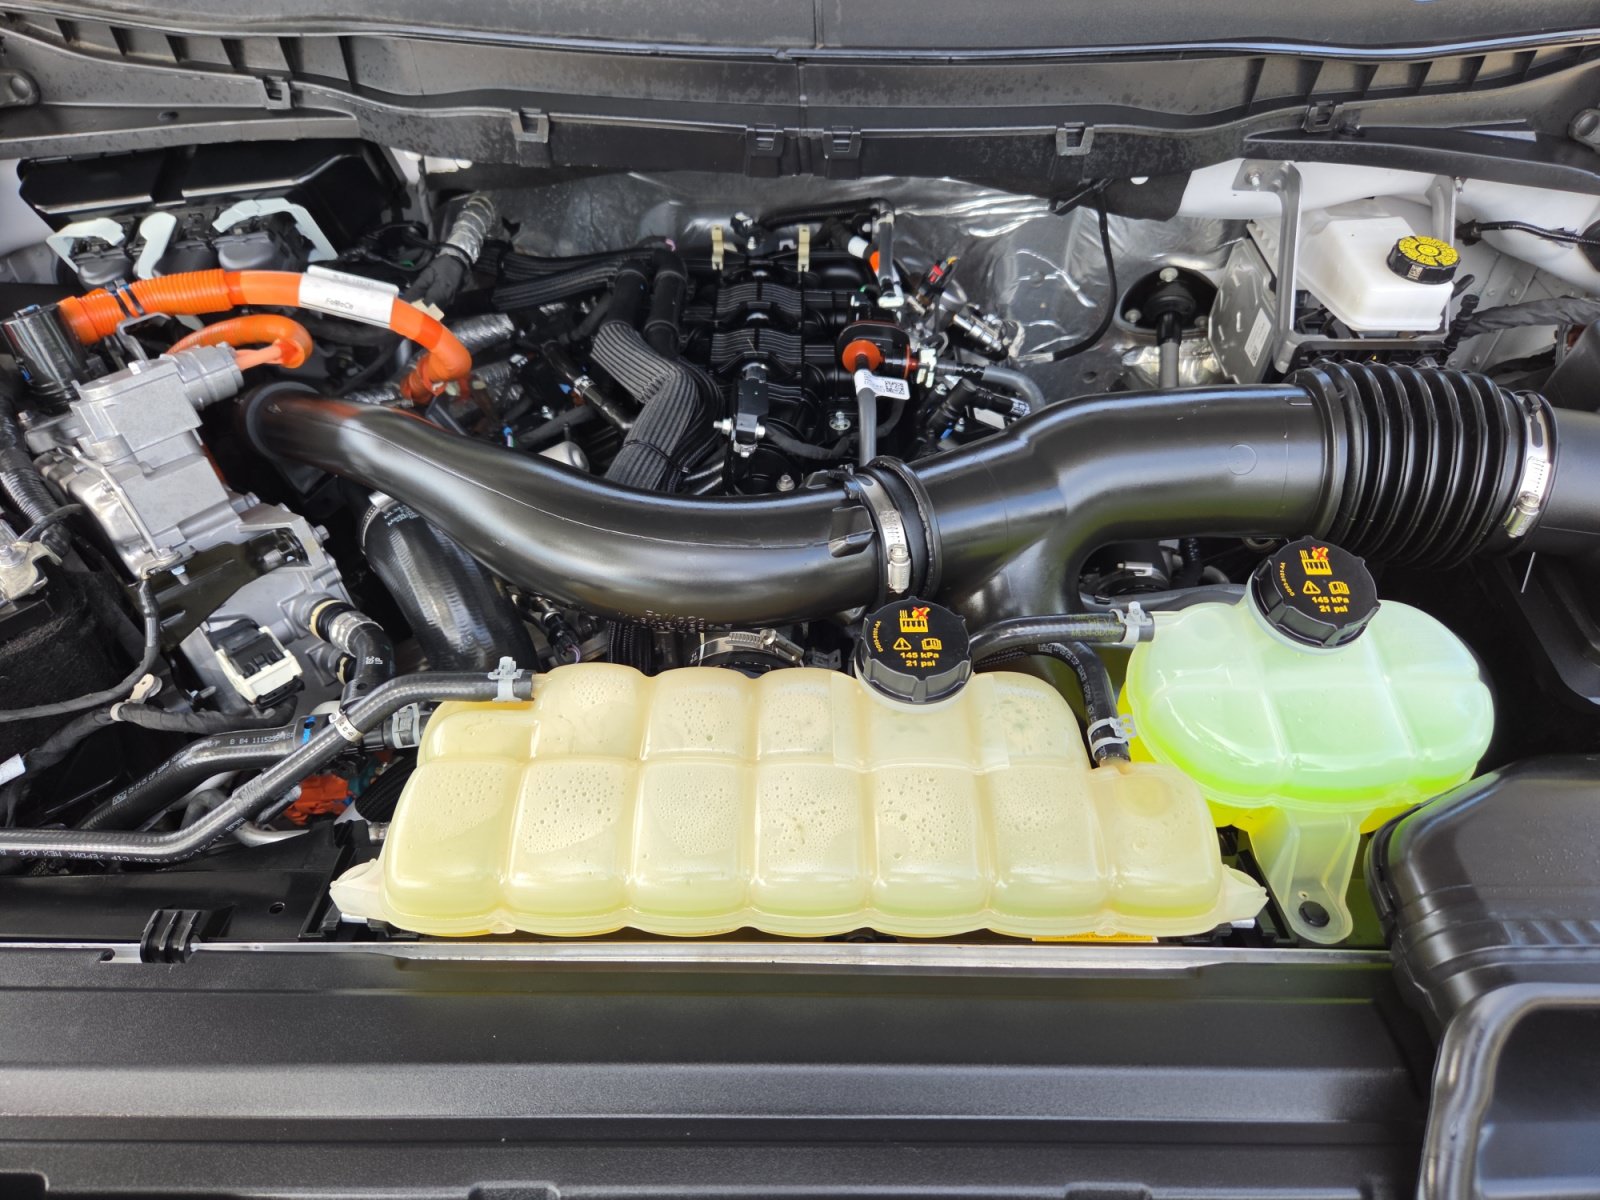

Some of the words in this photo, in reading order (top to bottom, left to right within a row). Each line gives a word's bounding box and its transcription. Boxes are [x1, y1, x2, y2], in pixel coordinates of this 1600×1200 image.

[1319, 605, 1331, 613] 21
[1334, 605, 1348, 614] psi
[900, 651, 918, 659] 145
[920, 651, 940, 659] kPa
[921, 660, 935, 668] psi
